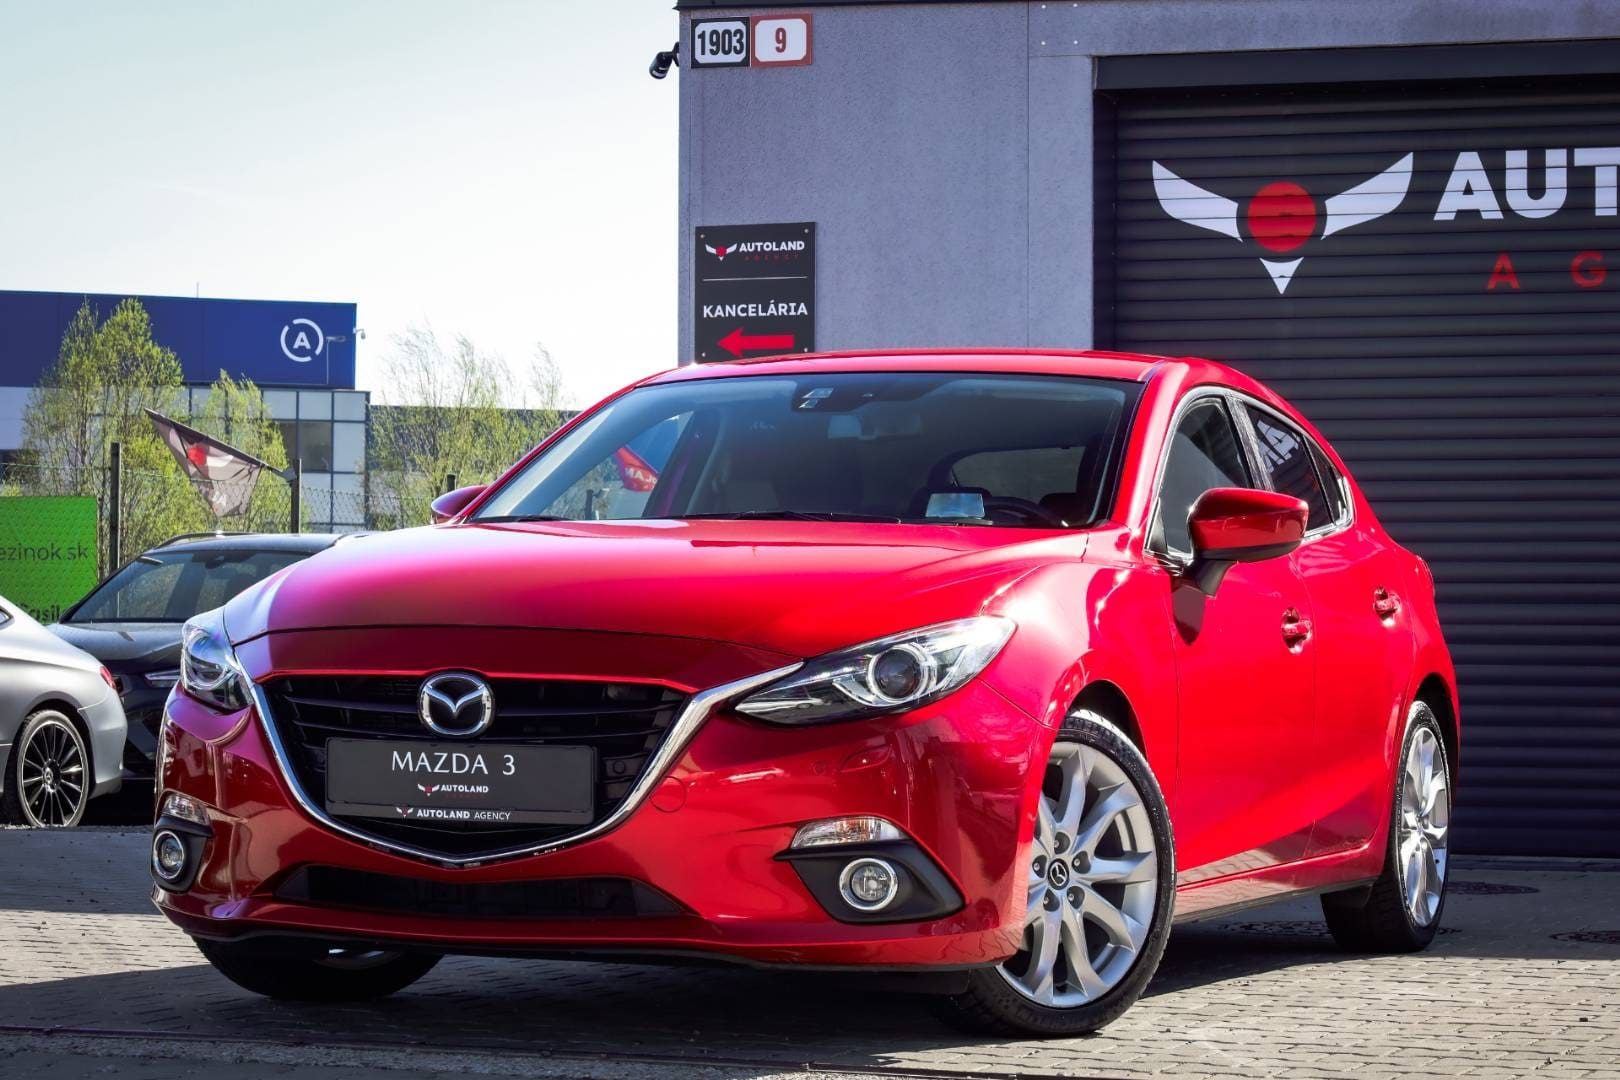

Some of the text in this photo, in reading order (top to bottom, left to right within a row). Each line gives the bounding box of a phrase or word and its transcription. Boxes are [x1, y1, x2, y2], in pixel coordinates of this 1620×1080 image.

[698, 28, 745, 56] 1903
[775, 27, 787, 53] 9
[1433, 147, 1620, 221] AUT
[739, 240, 805, 253] AUTOLAND
[703, 299, 808, 318] KANCELÁRIA
[392, 750, 516, 776] MAZDA 3
[440, 784, 489, 794] AUTOLAND
[416, 809, 511, 821] AUTOLAND AGENCY
